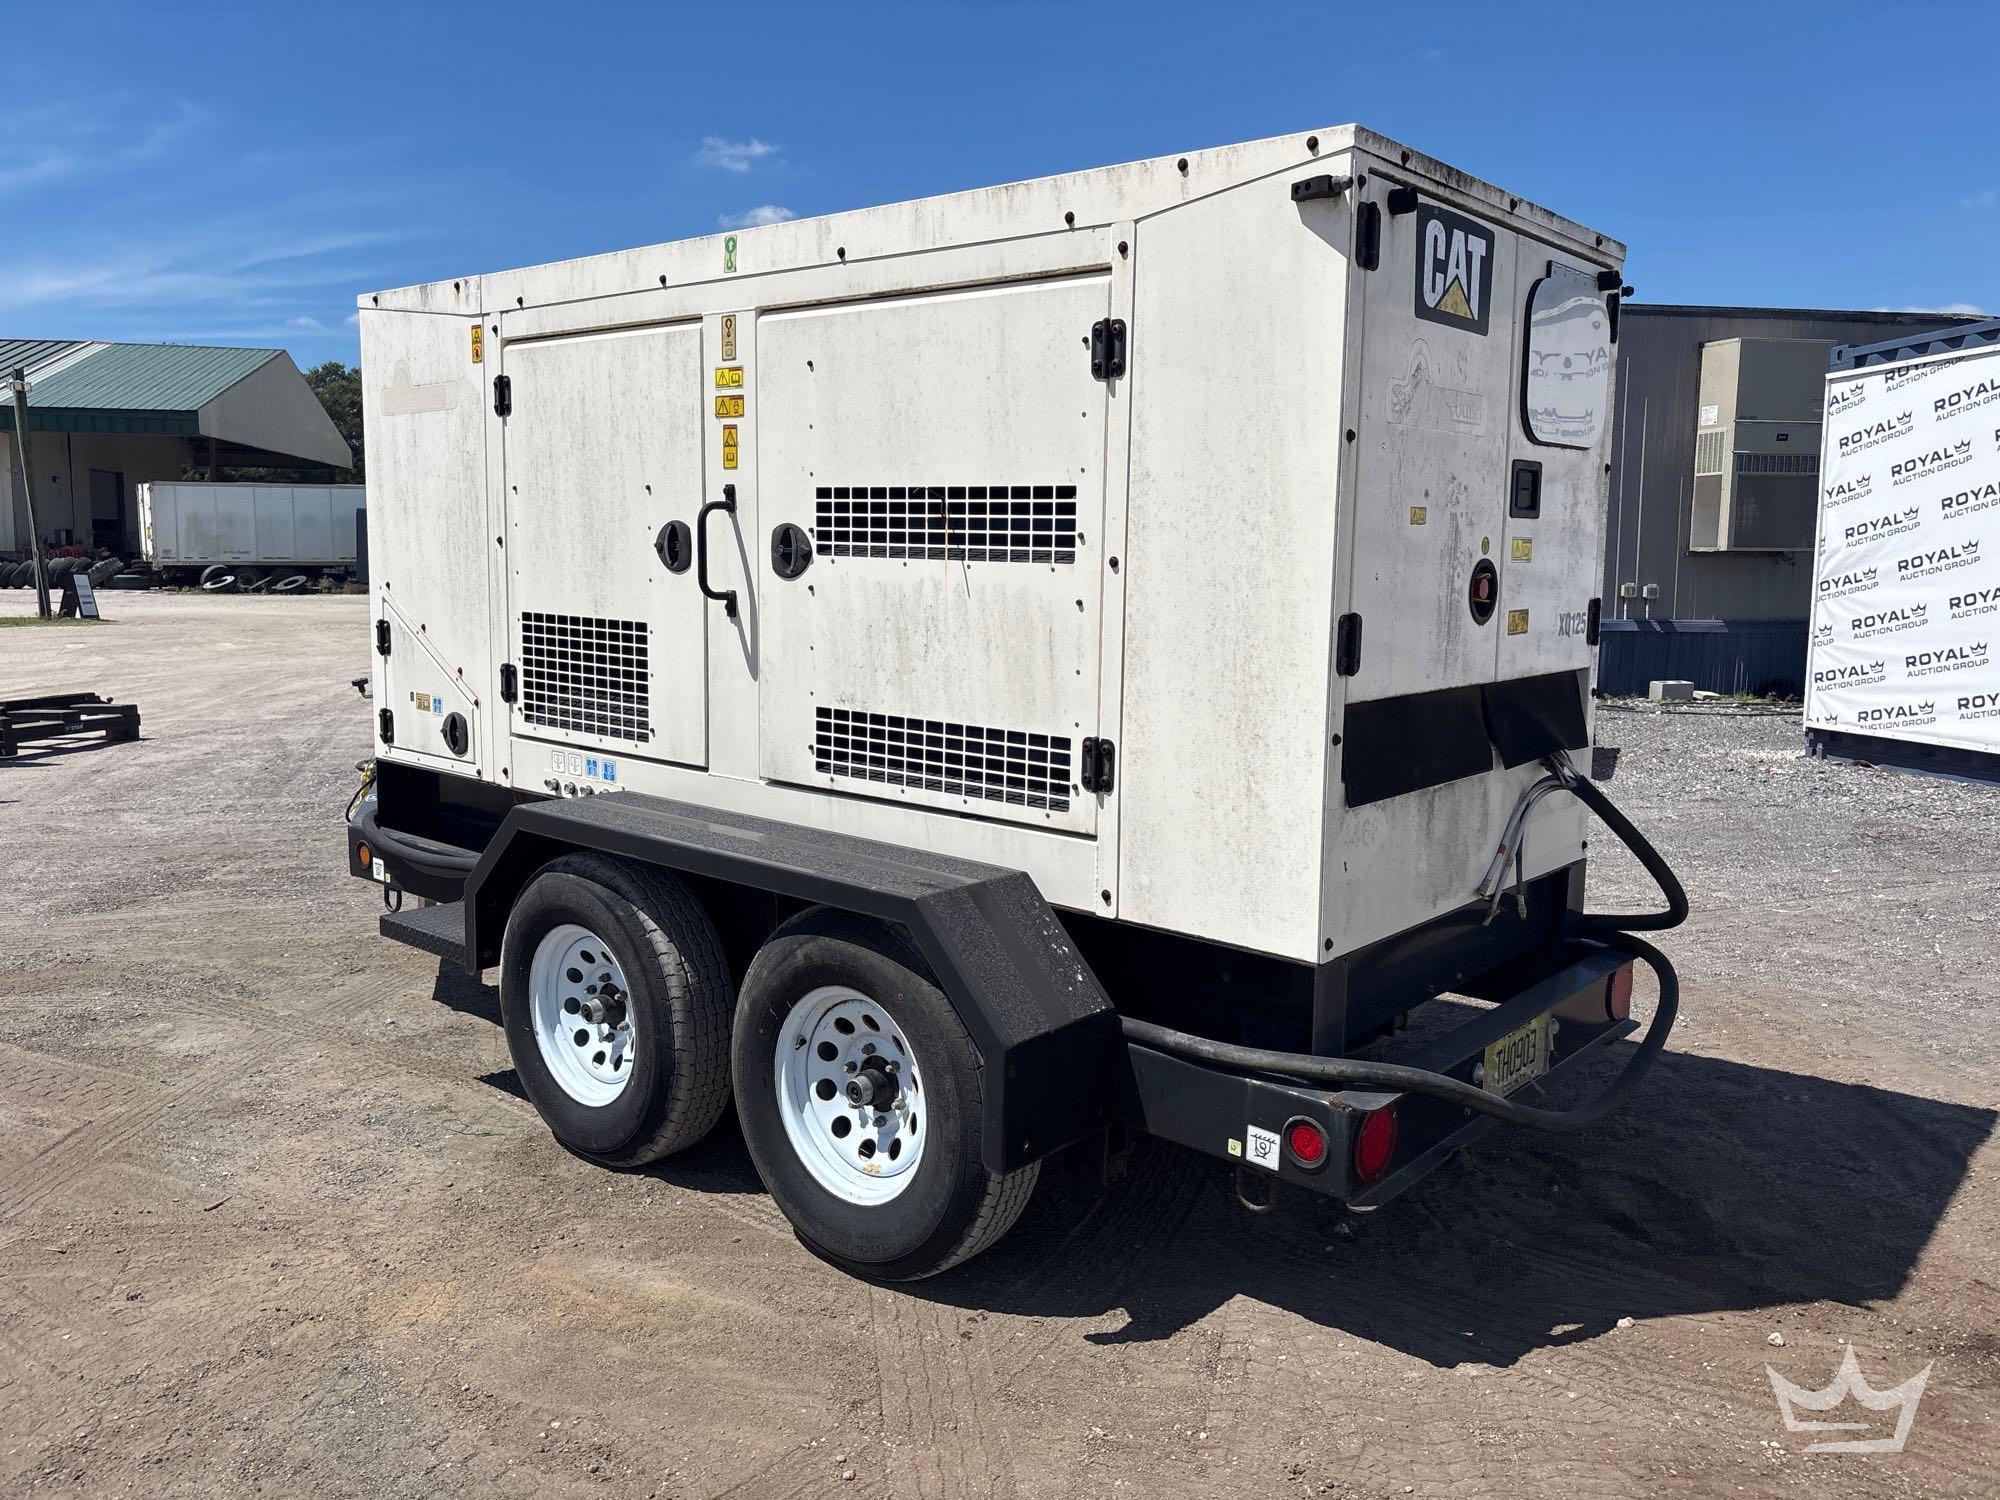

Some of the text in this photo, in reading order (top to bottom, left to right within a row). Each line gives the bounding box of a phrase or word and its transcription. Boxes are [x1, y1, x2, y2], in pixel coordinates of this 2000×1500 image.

[1424, 219, 1486, 320] CAT
[1886, 370, 1928, 393] AUCTION
[1930, 356, 1965, 375] GROUP
[1836, 397, 1866, 414] GROUP
[1934, 378, 2000, 412] ROYAL
[1936, 400, 1981, 422] AUCTION
[1839, 419, 1896, 449] ROYAL
[1841, 425, 1914, 458] AUCTION GROUP
[1891, 448, 1954, 477] ROYAL
[1893, 454, 1973, 487] AUCTION GROUP
[1841, 488, 1872, 504] GROUP
[1943, 501, 1989, 520] AUCTION
[1845, 513, 1903, 540] ROYAL
[1846, 521, 1921, 549] AUCTION GROUP
[1898, 546, 1961, 572] ROYAL
[1899, 555, 1981, 582] AUCTION GROUP
[1848, 581, 1879, 595] GROUP
[1851, 608, 1911, 630] ROYAL
[1951, 604, 1998, 620] AUCTION
[1558, 611, 1587, 639] XQ125
[1853, 618, 1928, 640] AUCTION GROUP
[1905, 647, 1970, 668] ROYAL
[1907, 658, 1989, 678] AUCTION GROUP
[1814, 664, 1869, 683] ROYAL
[1816, 675, 1886, 692] AUCTION GROUP
[1858, 705, 1918, 722] ROYAL
[1901, 716, 1937, 728] GROUP
[1959, 709, 2000, 720] AUCTIO
